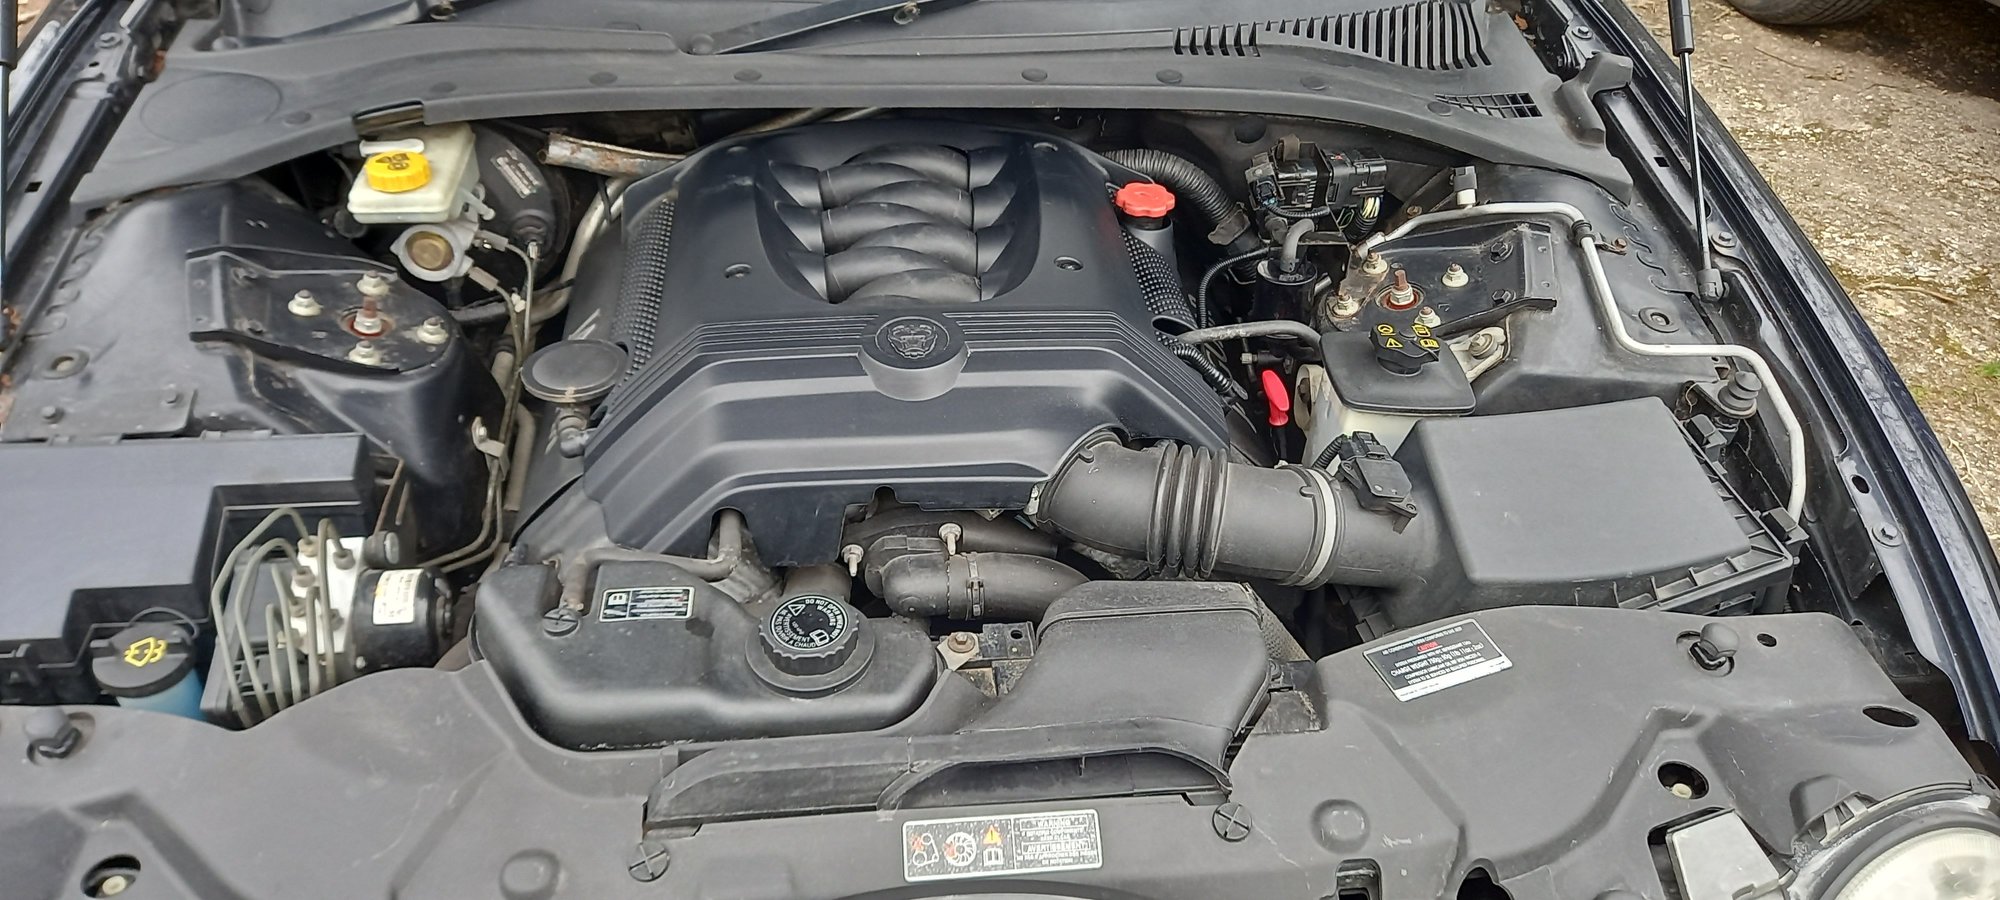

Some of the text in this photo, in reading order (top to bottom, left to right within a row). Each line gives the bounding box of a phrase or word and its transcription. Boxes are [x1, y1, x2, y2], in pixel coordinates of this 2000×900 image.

[817, 605, 836, 626] WARNING
[827, 603, 840, 615] OPEN
[775, 615, 783, 625] PAS
[836, 614, 844, 628] WHEN
[775, 625, 789, 642] OUVRIR
[783, 613, 810, 643] AVERTISSEMENT
[830, 628, 841, 639] HOT
[1417, 641, 1438, 651] CAUTION
[1390, 666, 1412, 676] CHARGE
[1410, 660, 1430, 670] WEIGHT
